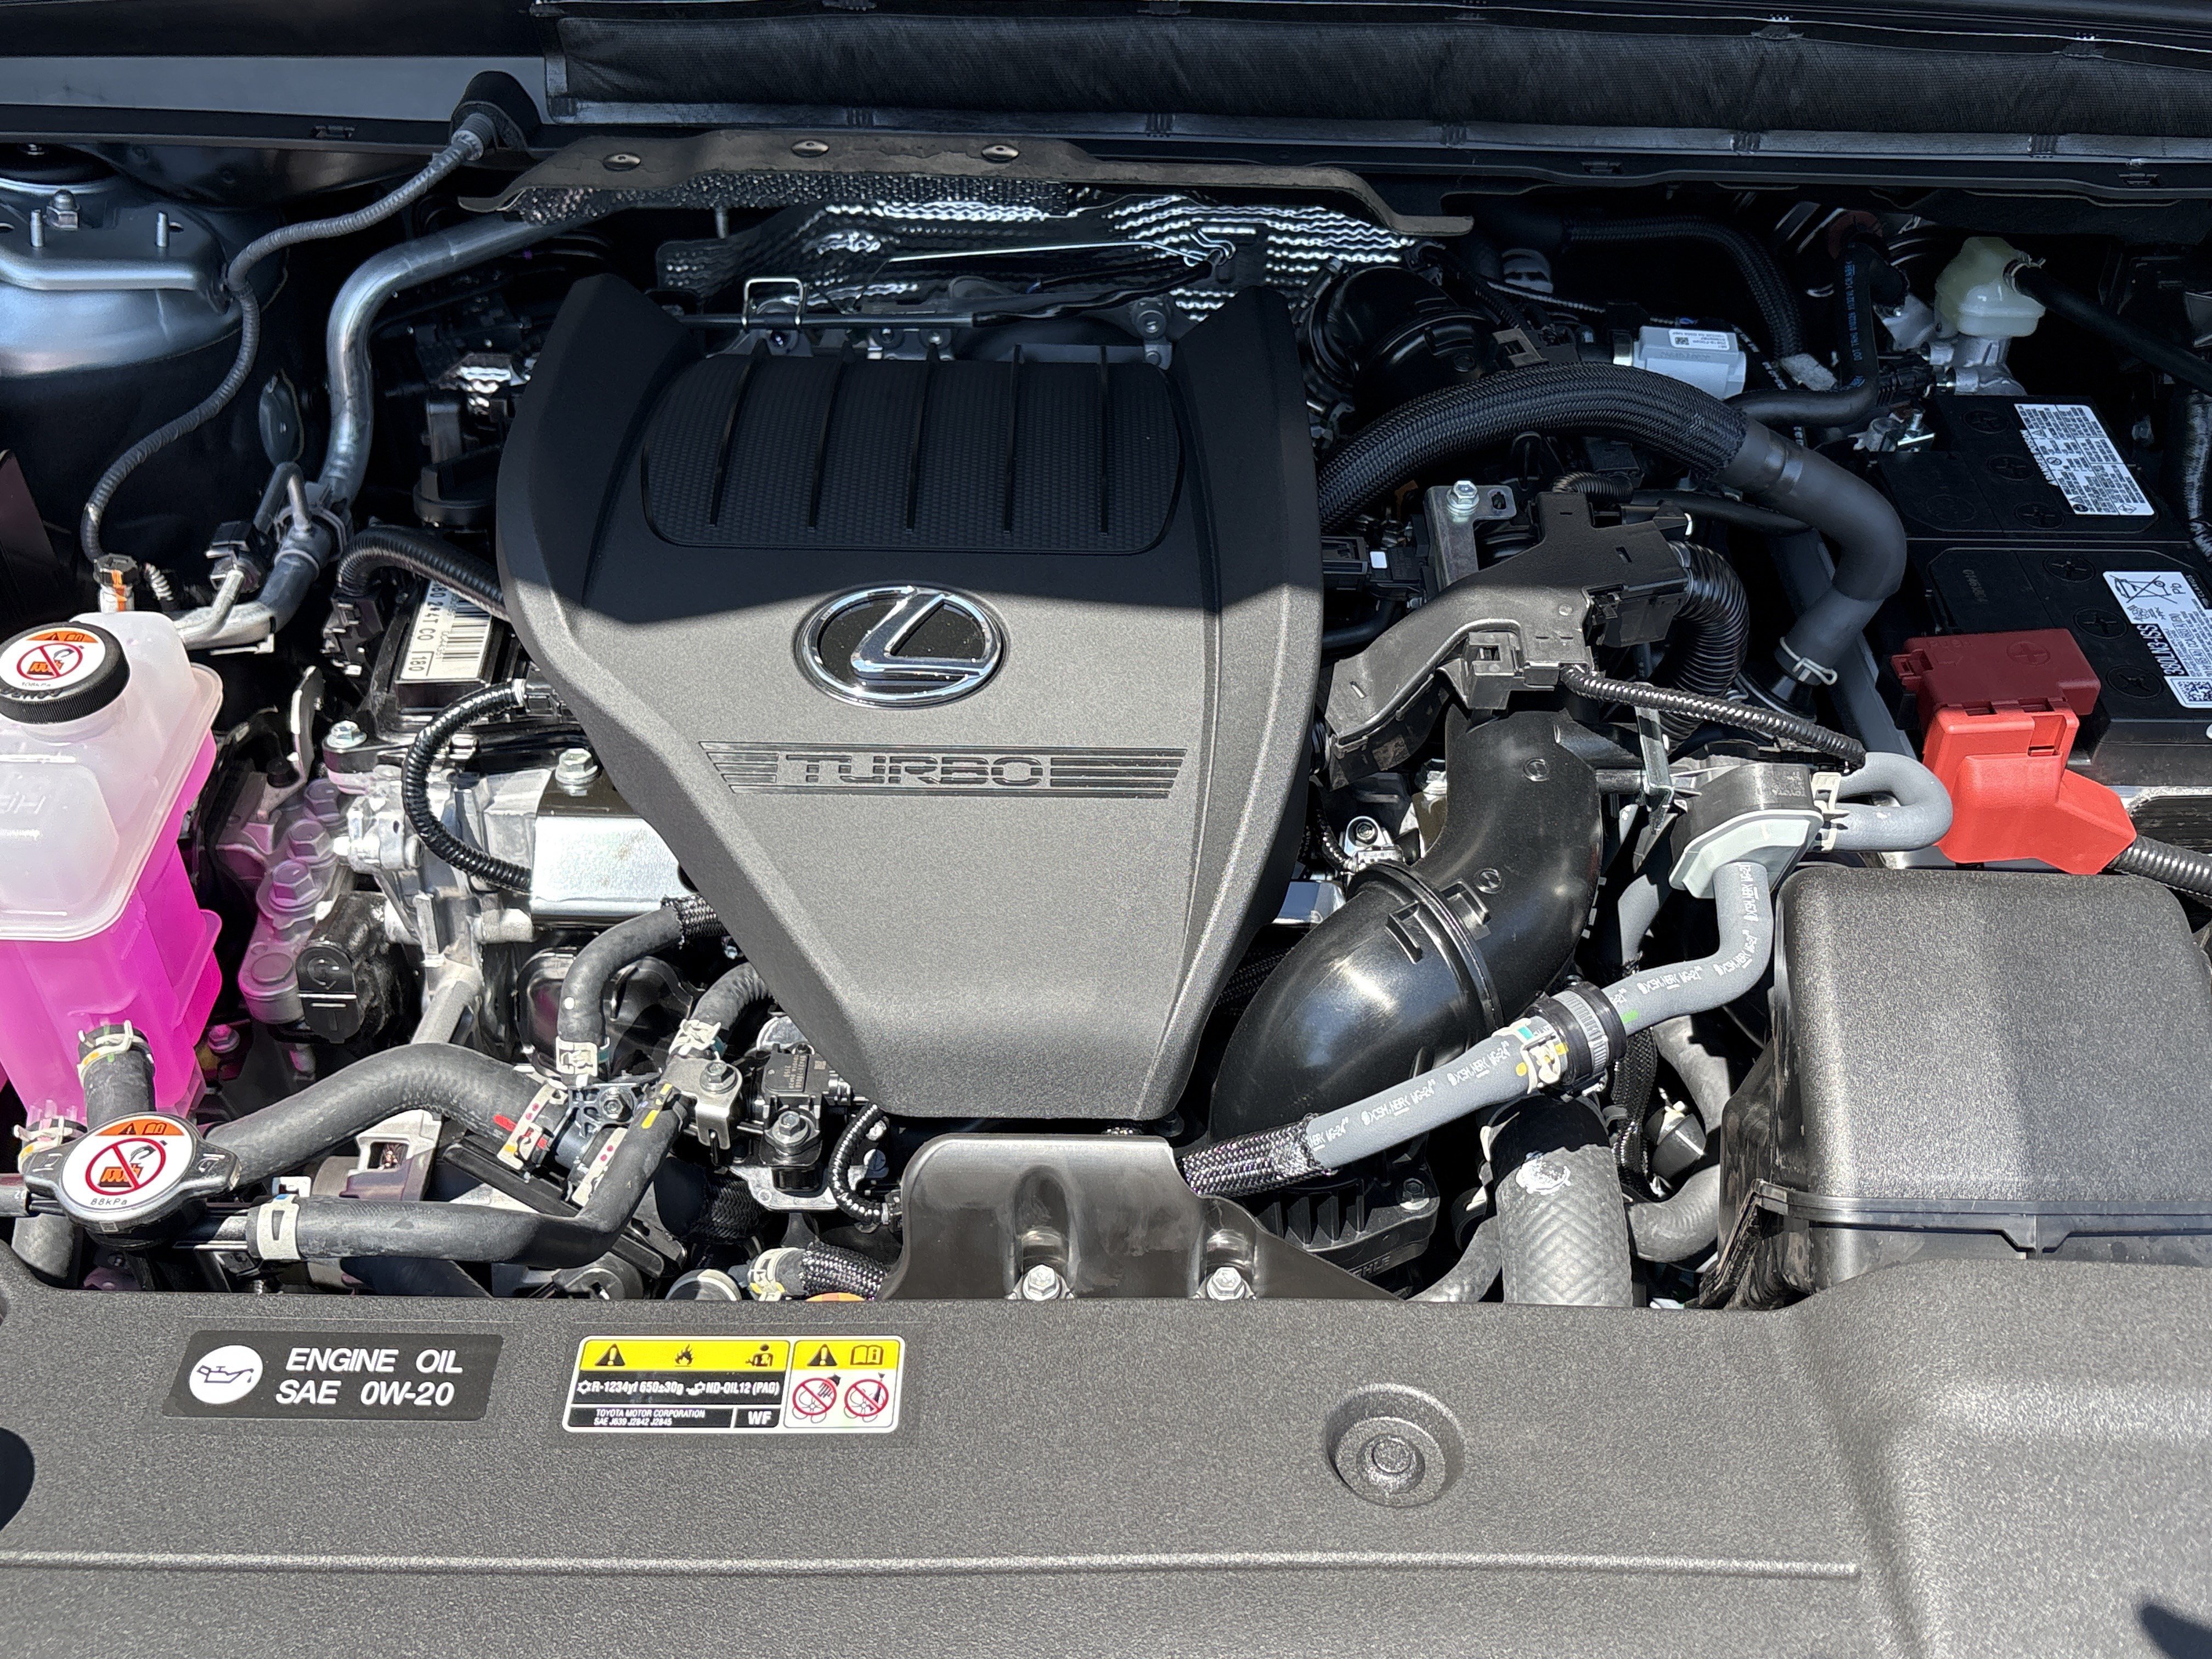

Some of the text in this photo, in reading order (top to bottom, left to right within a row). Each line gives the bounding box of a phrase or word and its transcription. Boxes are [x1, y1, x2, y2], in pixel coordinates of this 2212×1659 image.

[2169, 582, 2187, 595] Pb
[2136, 624, 2185, 676] 380LN3-ISS
[408, 656, 427, 672] 180
[785, 754, 1043, 787] TURBO
[285, 1347, 464, 1373] ENGINE OIL
[275, 1379, 455, 1406] SAE 0W-20
[596, 1408, 706, 1418] TOYOTA MOTOR CORPORATION
[748, 1410, 772, 1425] WF
[593, 1418, 610, 1426] SAE
